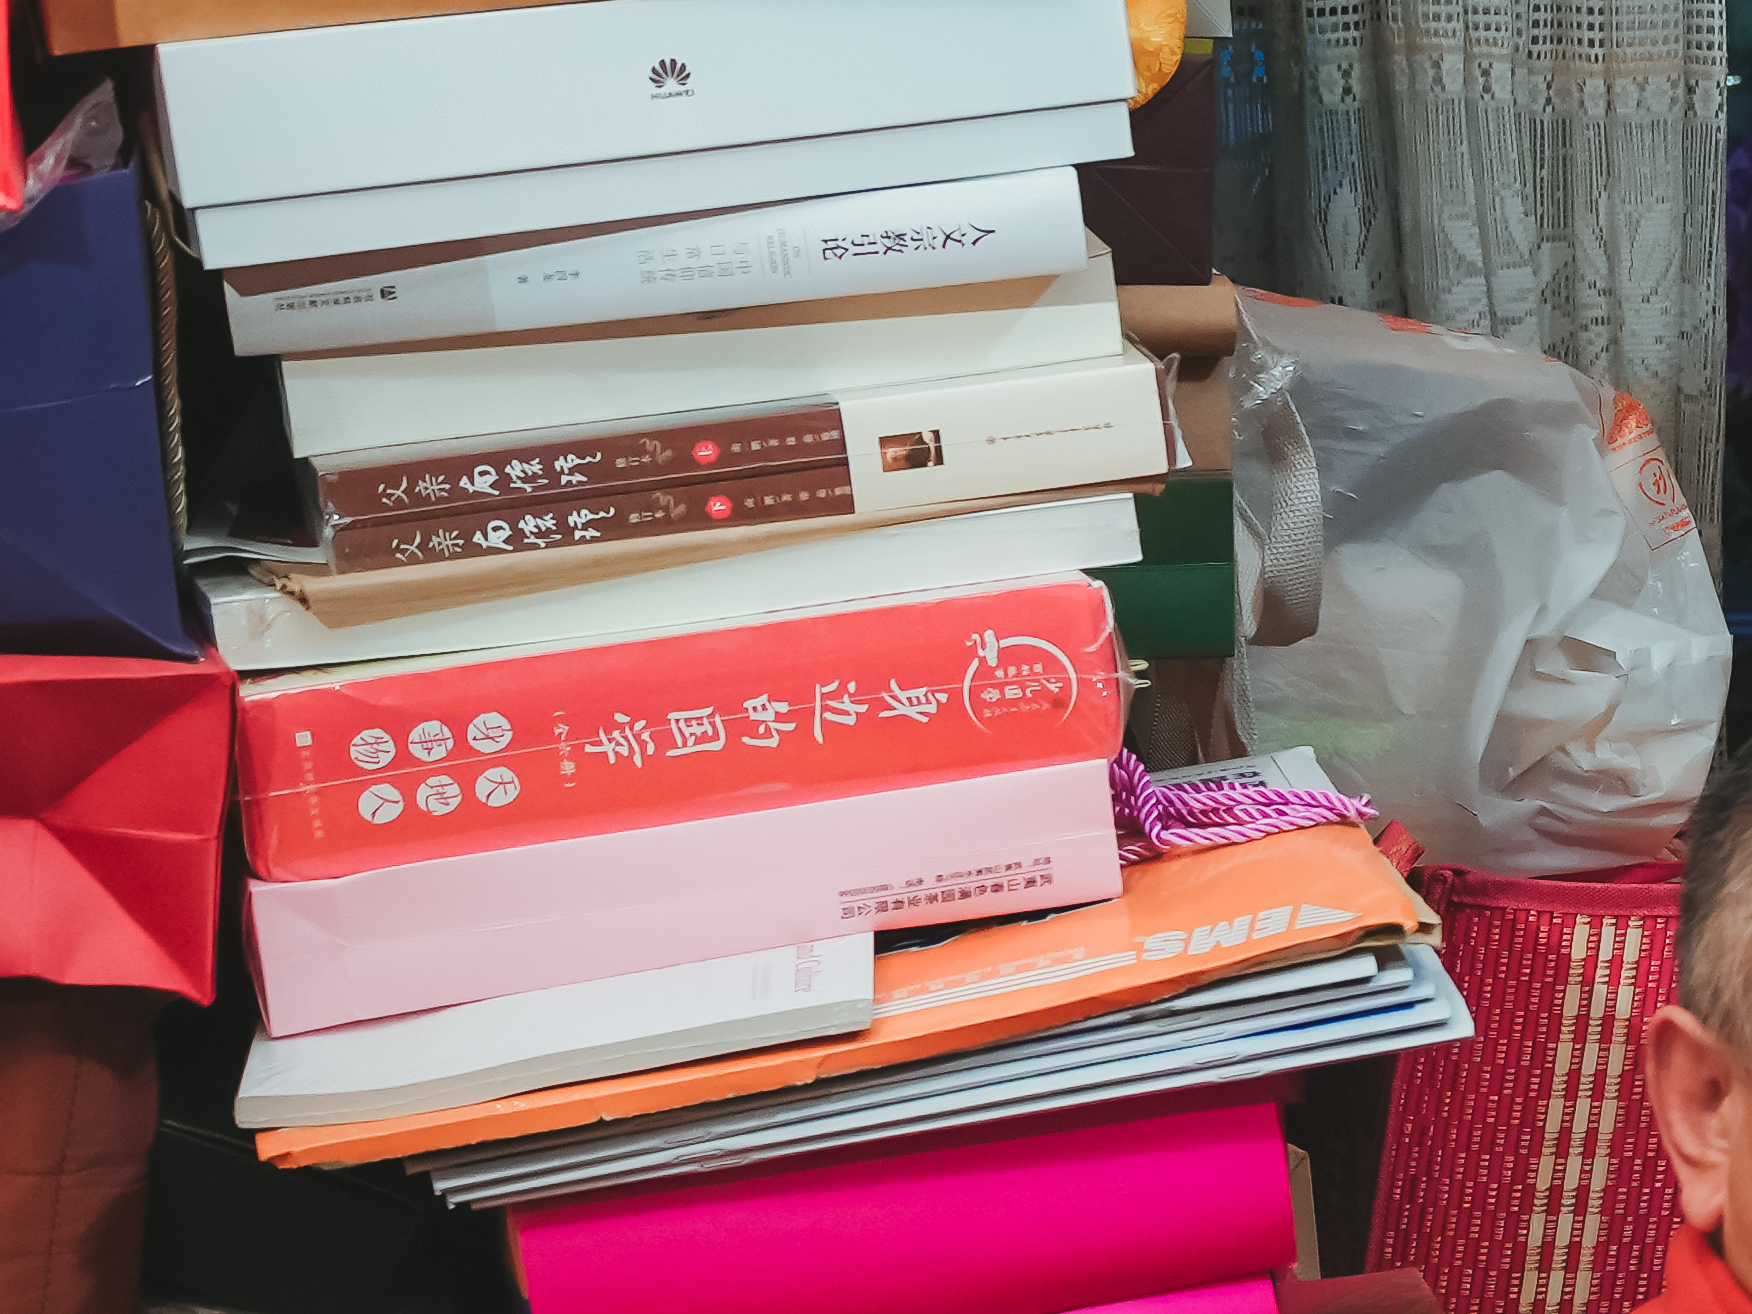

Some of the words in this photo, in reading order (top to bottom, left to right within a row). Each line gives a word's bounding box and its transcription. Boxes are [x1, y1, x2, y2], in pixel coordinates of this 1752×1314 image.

[821, 222, 996, 261] 人文宗教引论
[584, 677, 930, 769] 身边的国学
[1143, 904, 1295, 962] EMS
